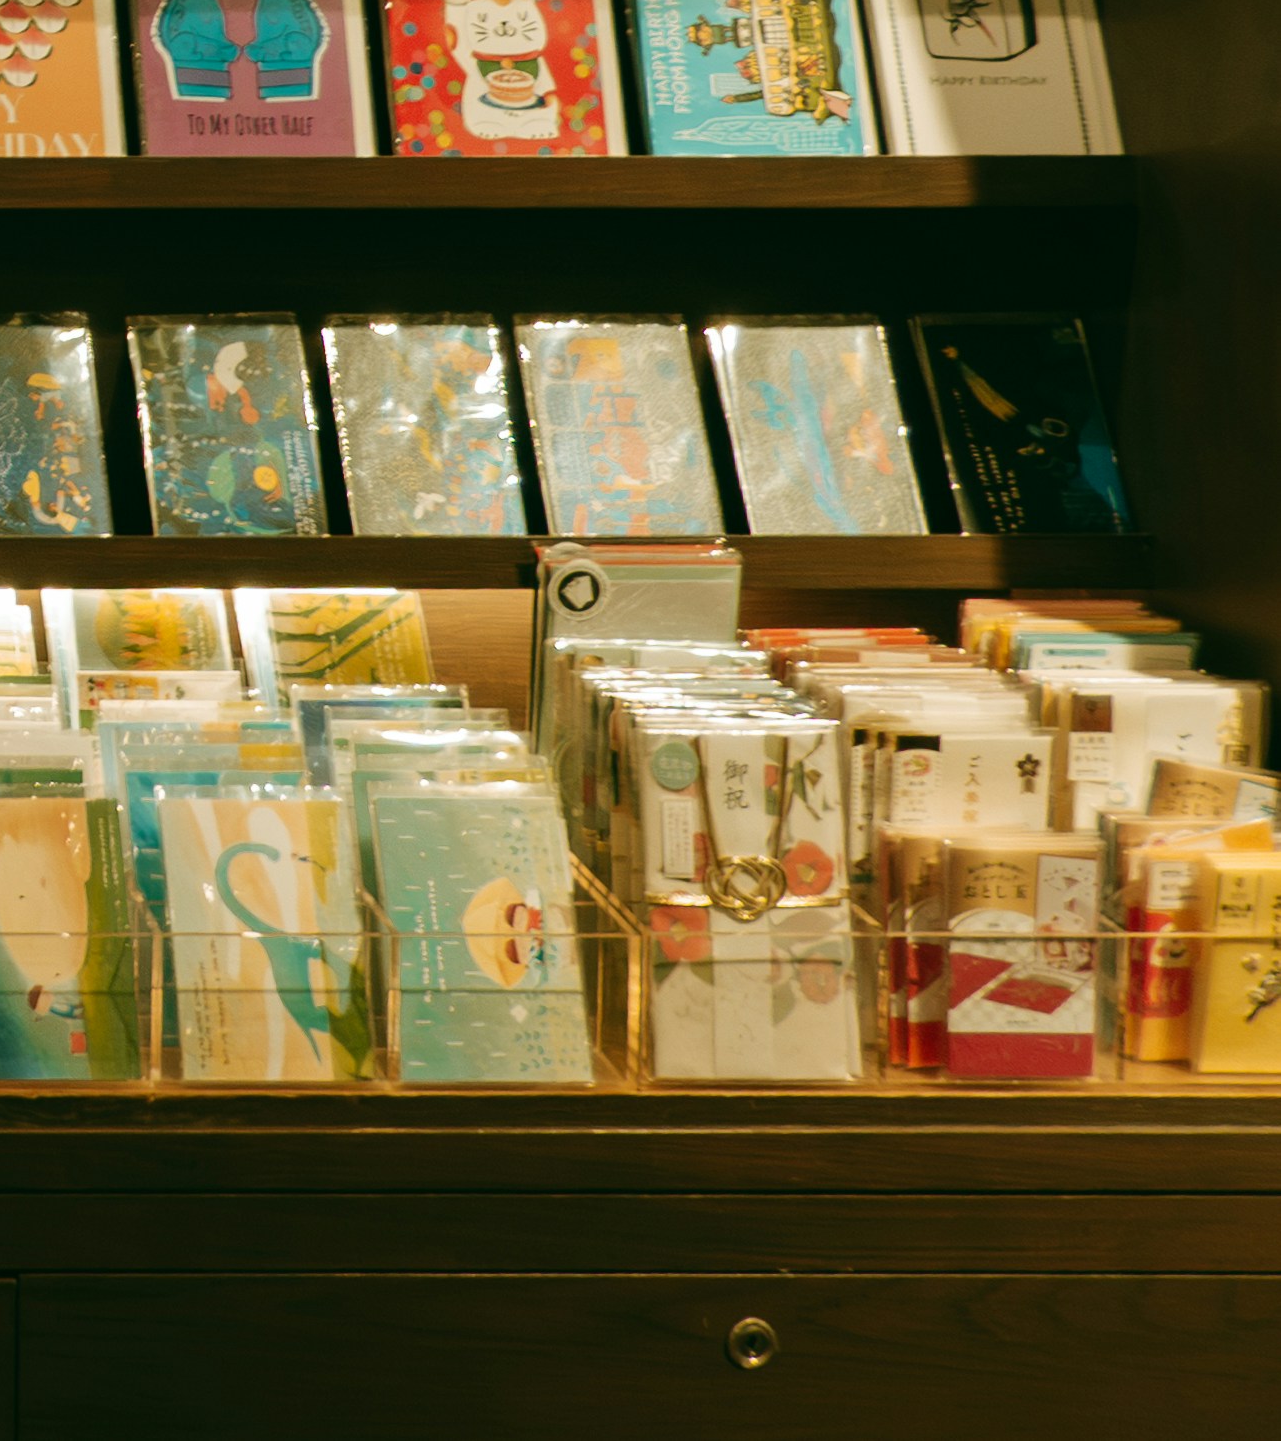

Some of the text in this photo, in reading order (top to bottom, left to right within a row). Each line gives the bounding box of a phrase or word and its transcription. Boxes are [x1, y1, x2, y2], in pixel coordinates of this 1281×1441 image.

[664, 10, 686, 64] HONG
[650, 49, 673, 106] HAPPY
[671, 66, 692, 115] FROM
[929, 75, 1048, 86] HAPPY BIRTHDAY
